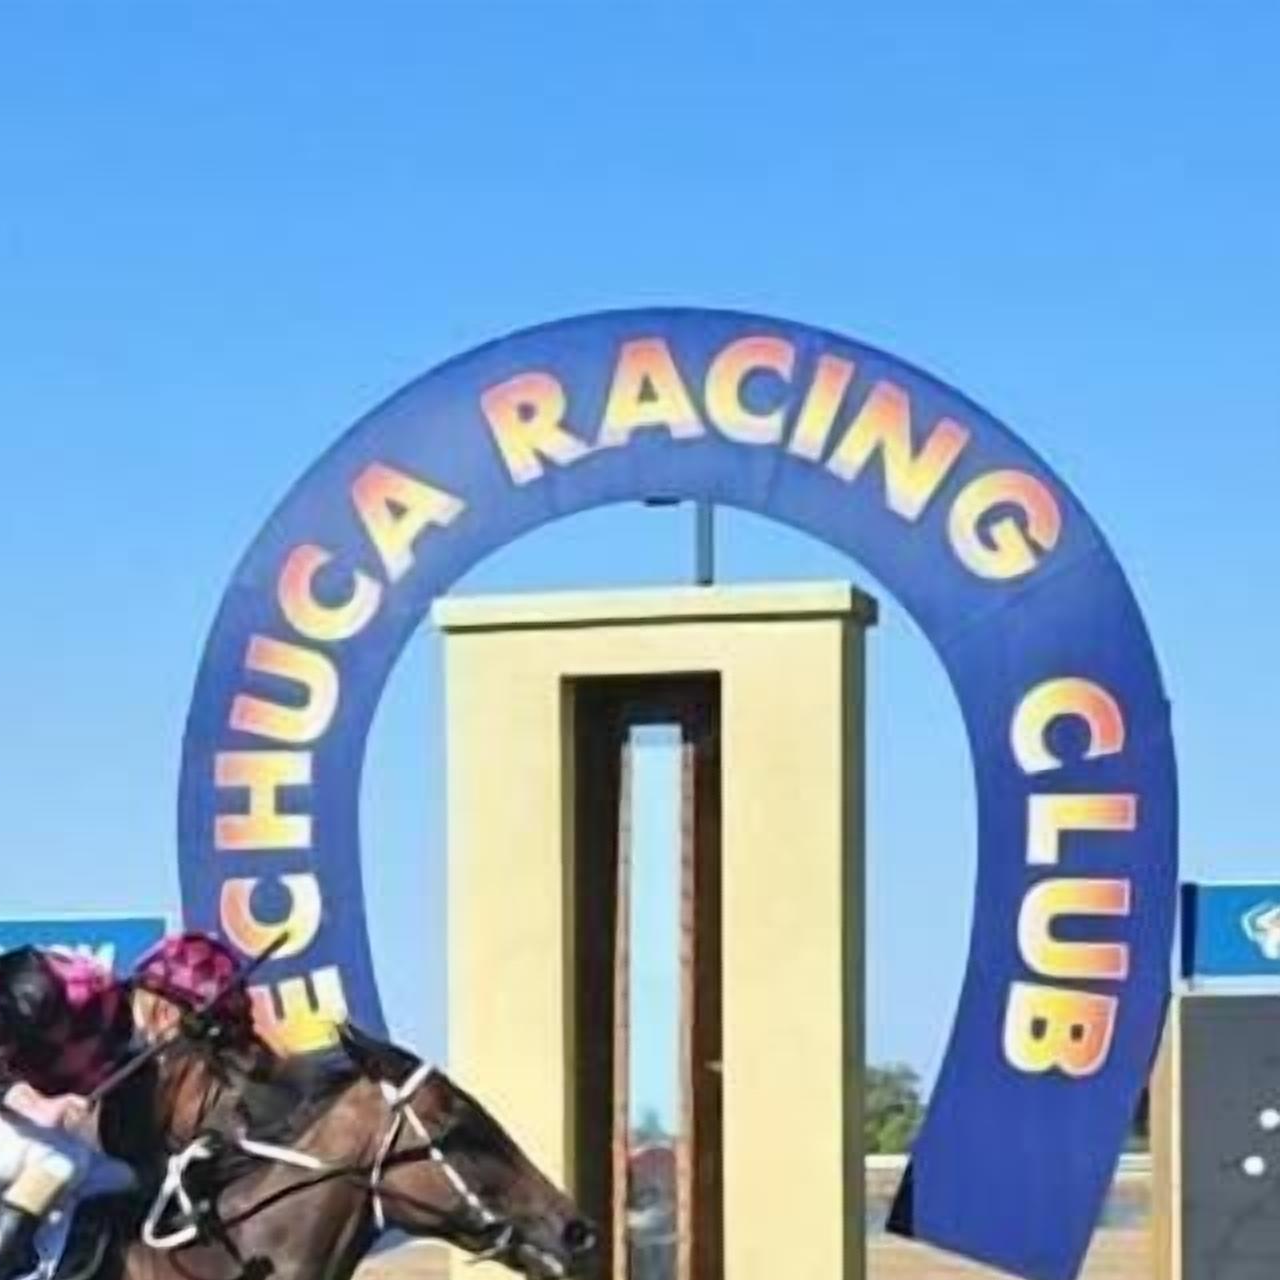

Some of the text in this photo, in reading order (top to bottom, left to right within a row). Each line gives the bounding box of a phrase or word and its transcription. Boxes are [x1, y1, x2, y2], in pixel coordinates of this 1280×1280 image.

[214, 335, 1138, 1077] ECHUCA RACING CLUB
